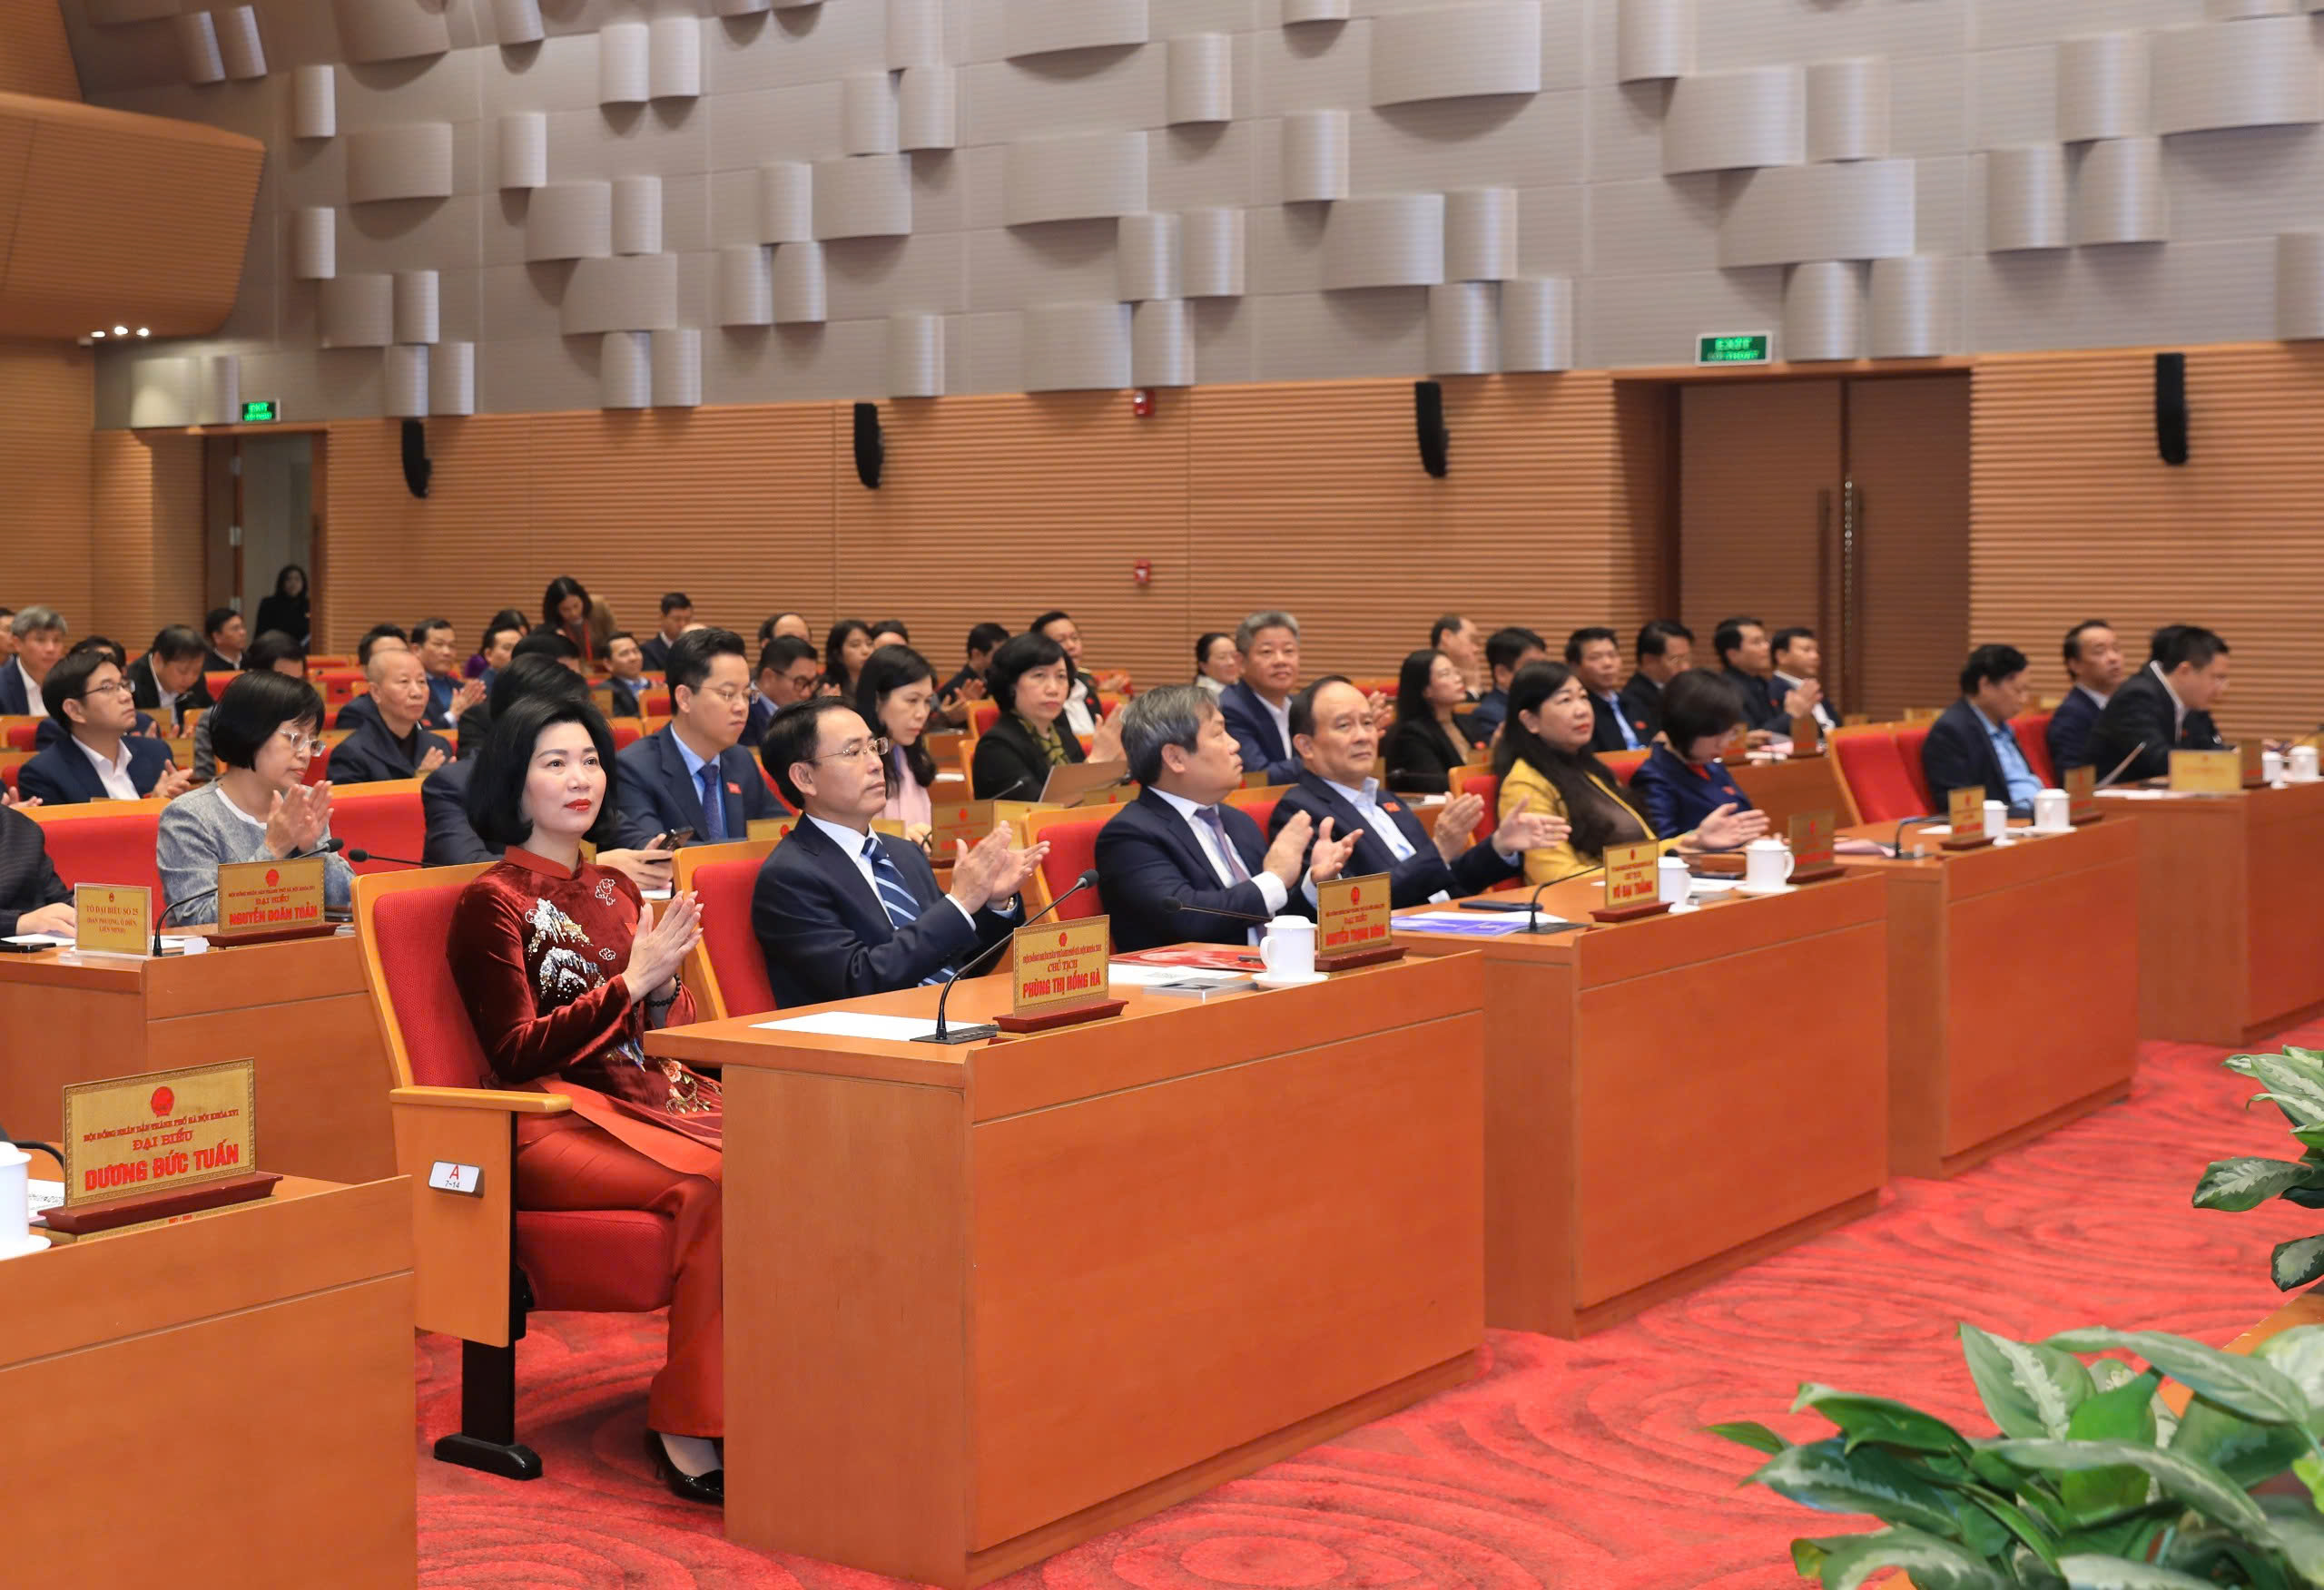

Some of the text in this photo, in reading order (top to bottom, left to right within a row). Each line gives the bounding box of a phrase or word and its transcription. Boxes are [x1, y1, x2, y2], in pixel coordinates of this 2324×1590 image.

[229, 907, 266, 926] NGUYỄN
[1047, 958, 1078, 973] CHỦ TỊCH
[1022, 967, 1100, 998] PHÙNG THỊ HỒNG HÀ
[133, 1127, 194, 1151] ĐẠI BIỂU
[84, 1138, 240, 1191] DƯƠNG ĐỨC TUẤN
[448, 1164, 459, 1180] A
